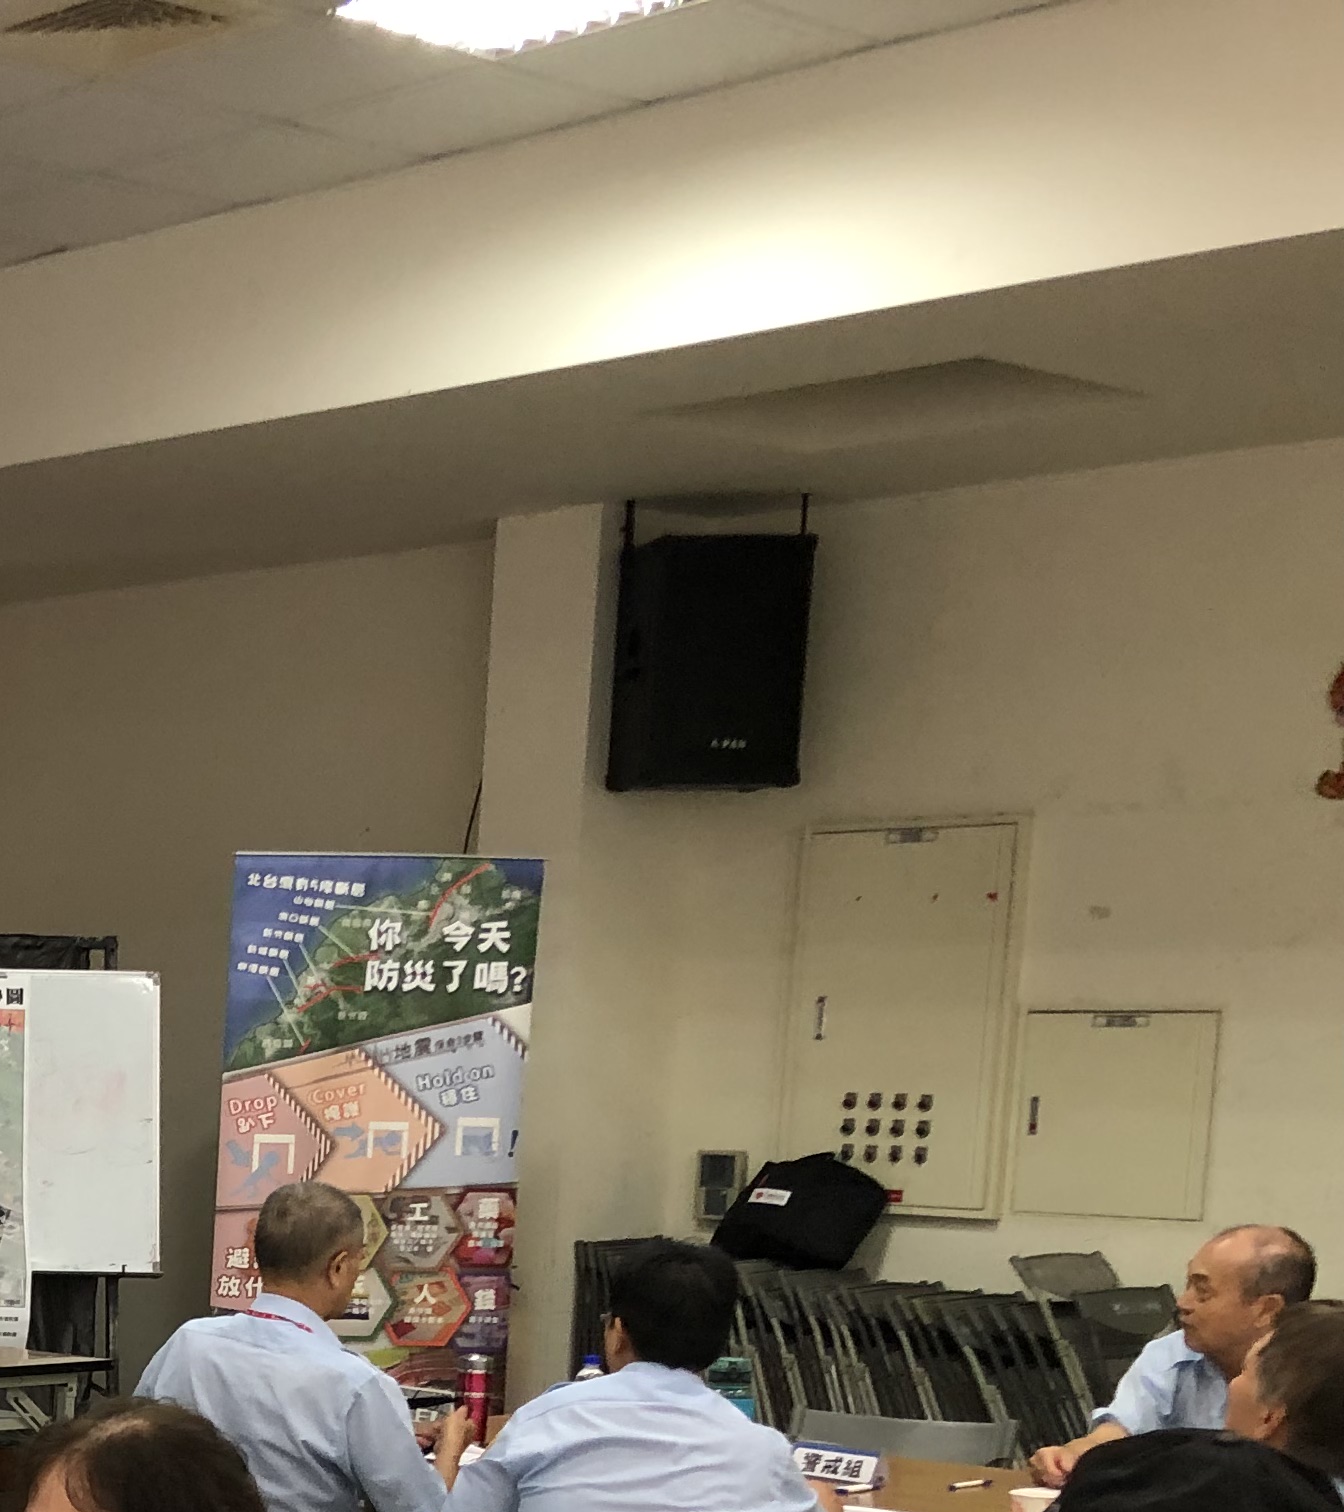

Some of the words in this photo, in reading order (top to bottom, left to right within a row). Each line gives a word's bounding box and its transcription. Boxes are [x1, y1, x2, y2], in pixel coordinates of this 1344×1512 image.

[368, 918, 402, 951] 你
[442, 920, 511, 953] 今天
[364, 958, 528, 994] 防災了嗎?
[416, 1066, 461, 1092] Hold
[470, 1064, 494, 1082] on
[312, 1083, 366, 1104] Cover
[229, 1095, 278, 1115] Drop
[237, 1112, 274, 1133] 趴下
[407, 1203, 428, 1220] 工
[225, 1248, 259, 1269] 避
[414, 1284, 436, 1304] 人
[801, 1452, 863, 1479] 警戒組
